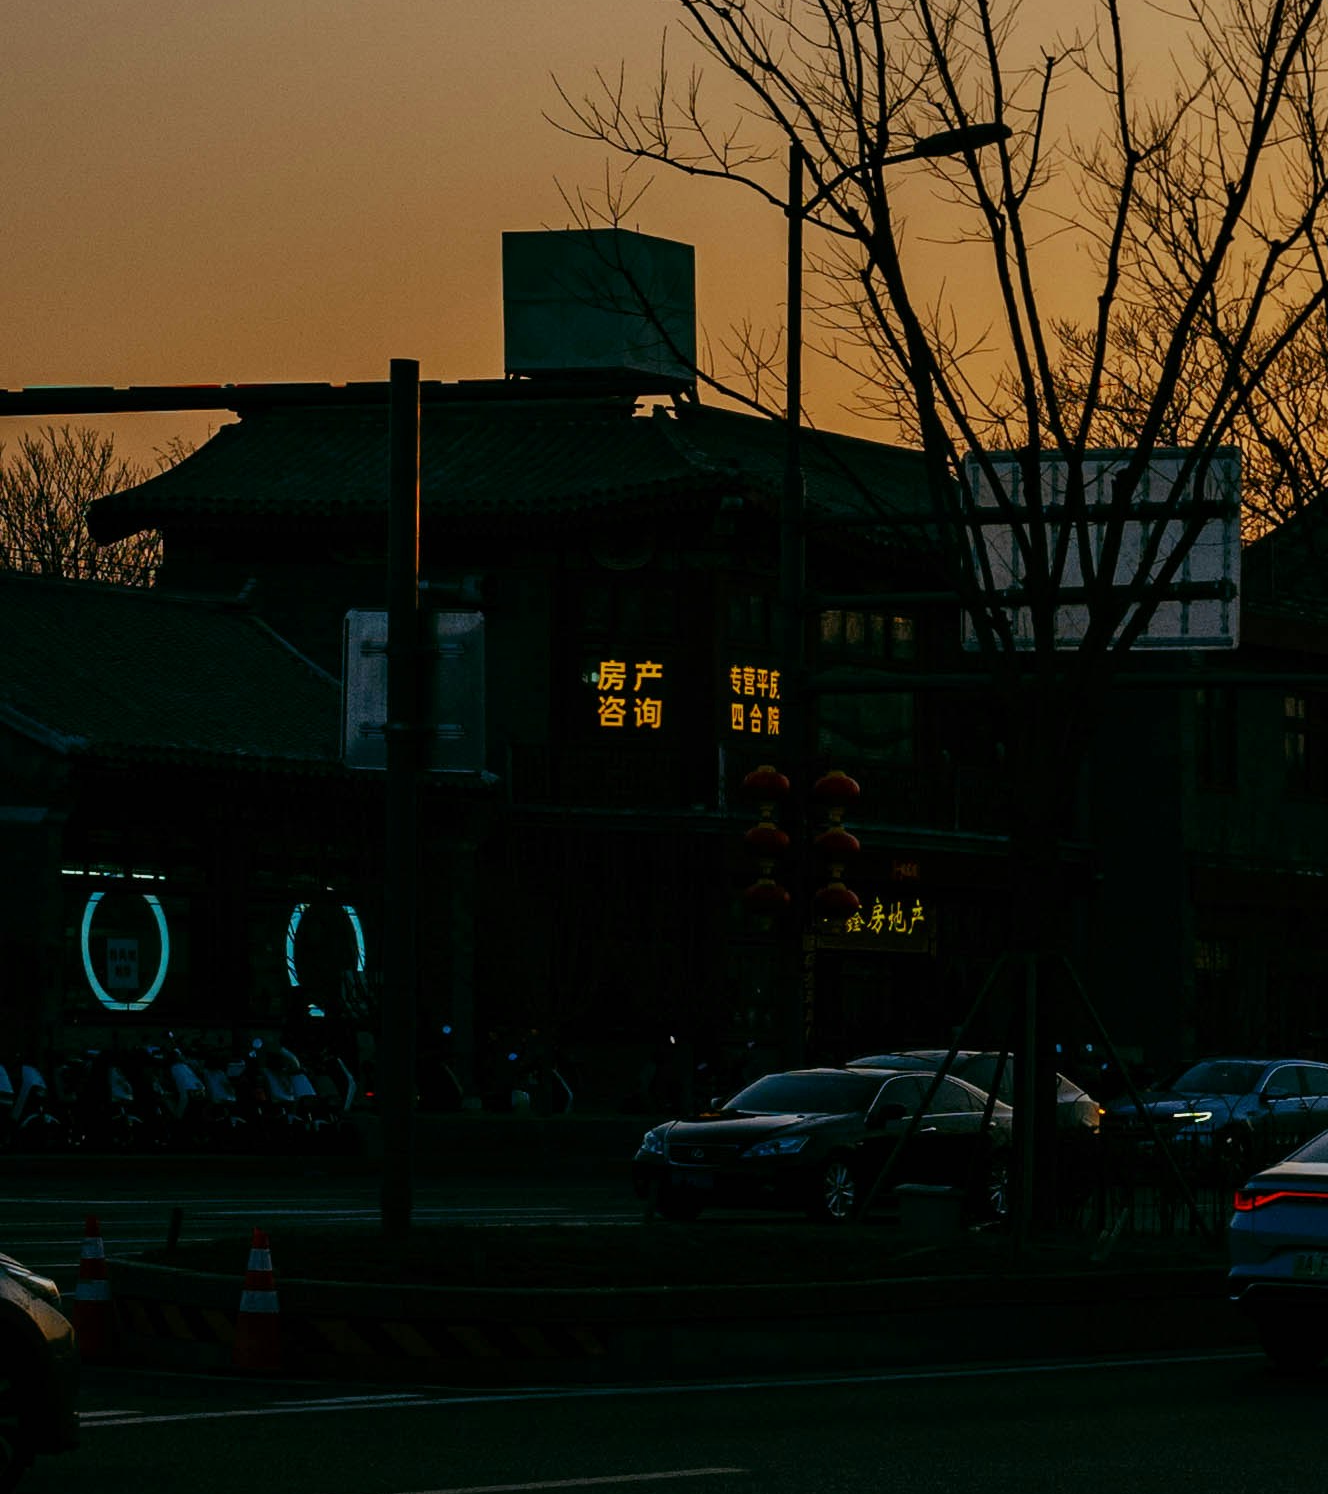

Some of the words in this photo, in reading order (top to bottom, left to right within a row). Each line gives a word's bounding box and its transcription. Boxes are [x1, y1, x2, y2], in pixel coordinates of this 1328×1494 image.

[598, 660, 662, 691] 房产
[598, 696, 662, 728] 咨询
[731, 703, 781, 735] 四合院
